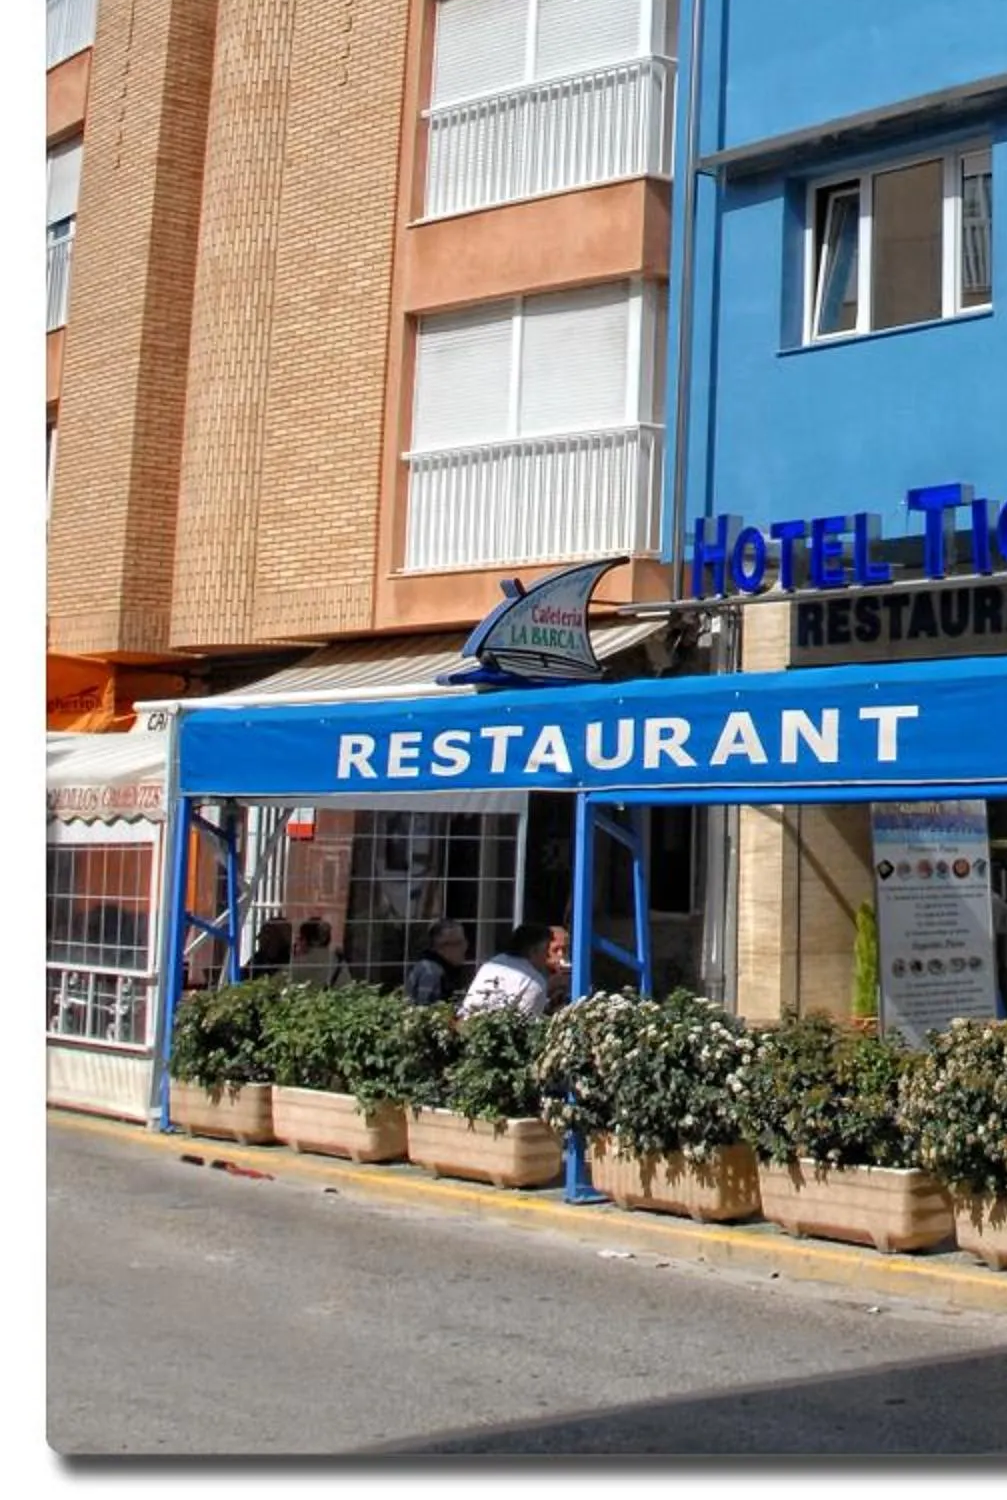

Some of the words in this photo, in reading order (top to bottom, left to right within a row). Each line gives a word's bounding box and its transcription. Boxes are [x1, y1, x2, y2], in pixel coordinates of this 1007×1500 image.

[693, 512, 891, 599] HOTEL
[511, 625, 527, 645] LA
[336, 705, 920, 780] RESTAURANT
